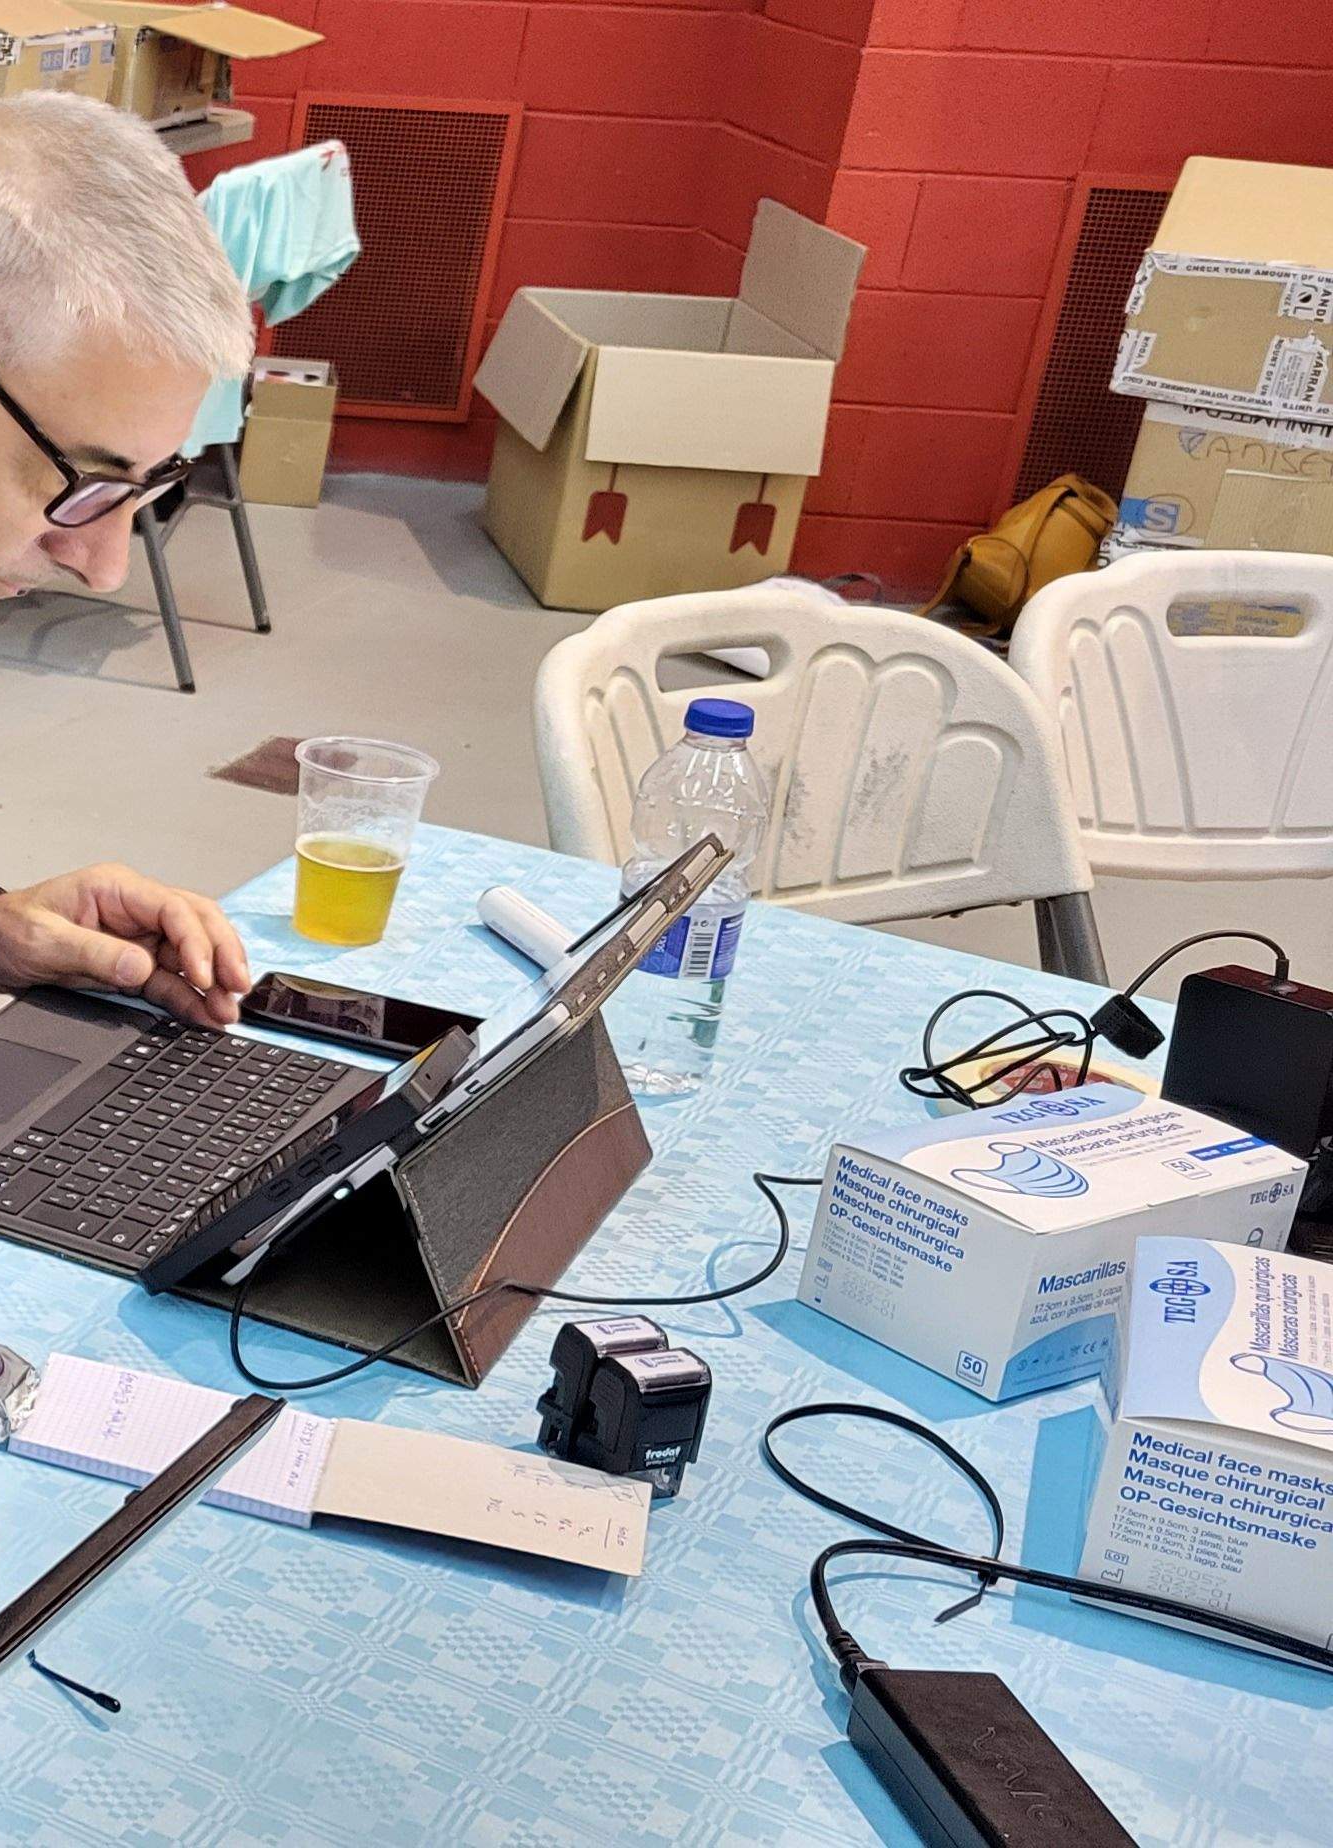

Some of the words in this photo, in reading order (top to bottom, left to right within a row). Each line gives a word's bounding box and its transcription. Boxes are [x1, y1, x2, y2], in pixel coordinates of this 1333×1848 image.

[832, 1185, 894, 1226] Maschera
[895, 1215, 965, 1260] chirurgica
[835, 1170, 885, 1204] Masque
[888, 1196, 960, 1239] chirurgical
[838, 1155, 890, 1190] Medical
[892, 1180, 921, 1204] face
[924, 1194, 969, 1227] masks
[829, 1203, 953, 1273] OP-Gesichtsmaske
[1037, 1260, 1127, 1296] Mascarillas
[961, 1355, 982, 1376] 50
[645, 1445, 681, 1460] trodat
[1128, 1448, 1209, 1481] Masque
[1215, 1474, 1325, 1511] chirurgical
[1133, 1431, 1213, 1464] Medical
[1218, 1453, 1262, 1476] face
[1268, 1468, 1333, 1495] masks
[1120, 1486, 1317, 1549] OP-Gesichtsmaske
[1124, 1466, 1224, 1504] Maschera
[1230, 1498, 1333, 1533] chirurgica
